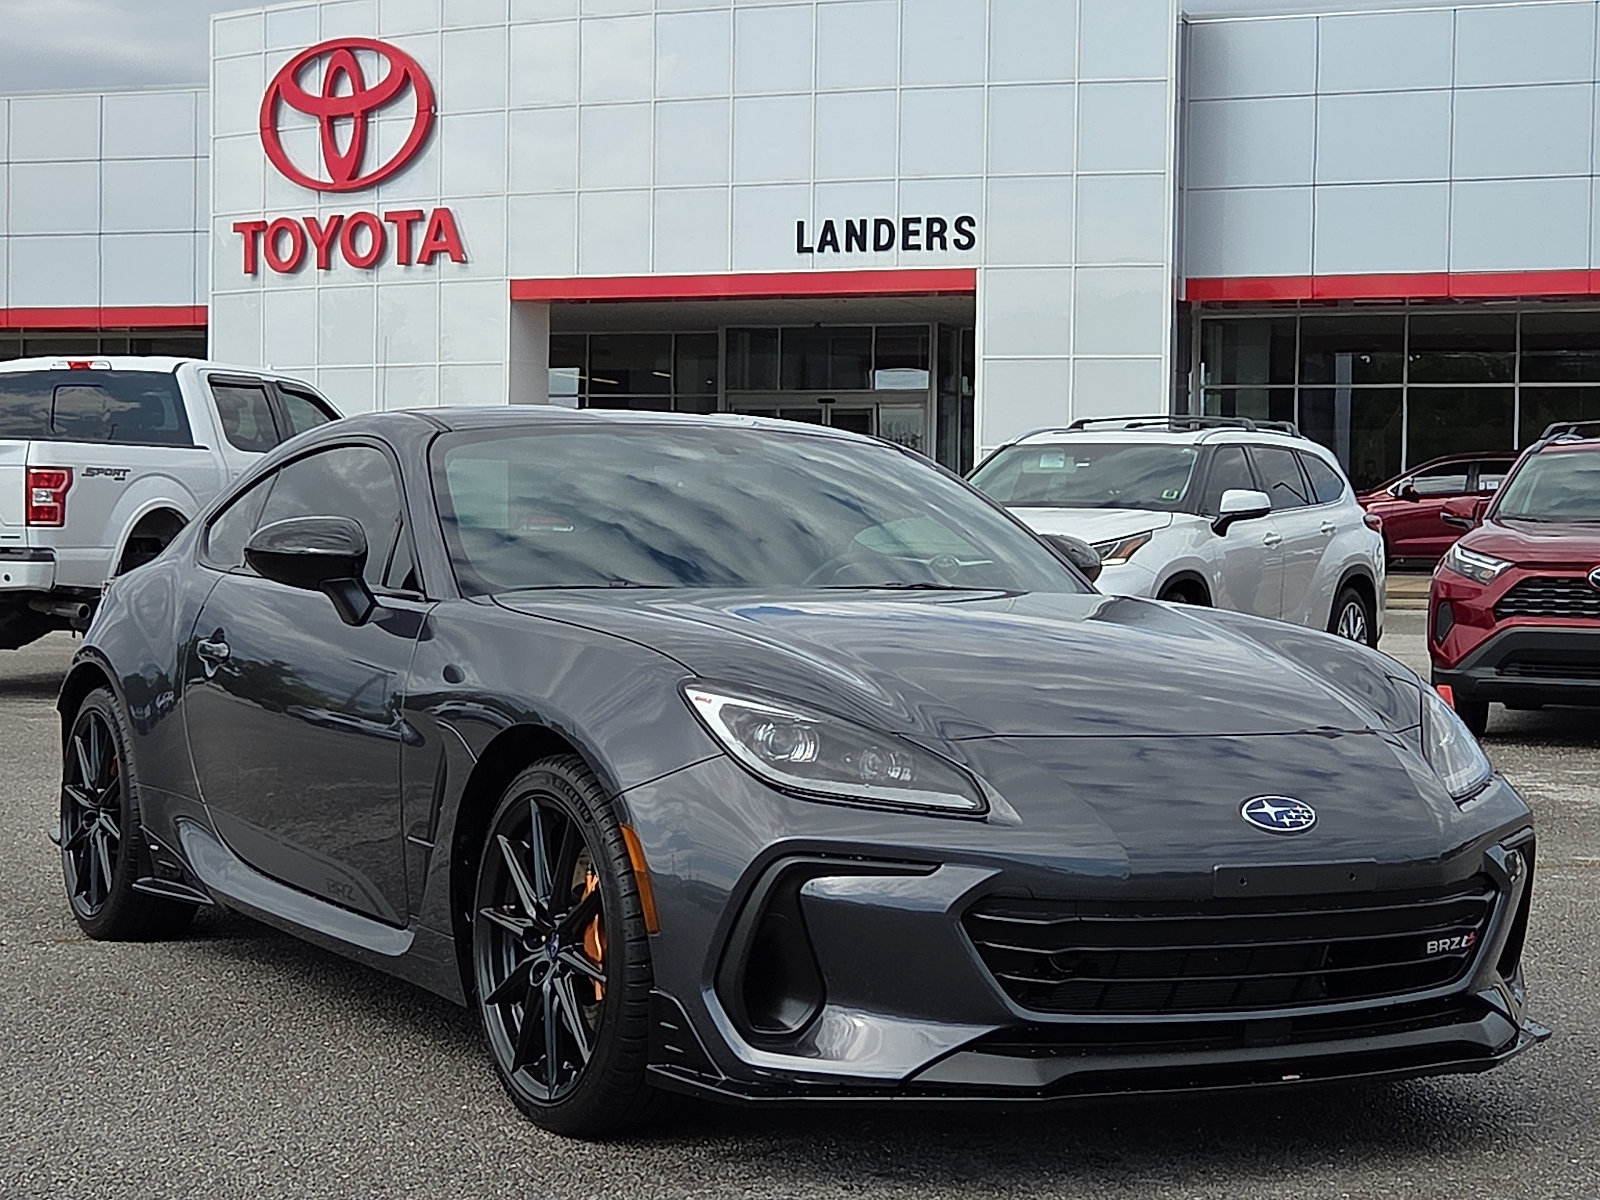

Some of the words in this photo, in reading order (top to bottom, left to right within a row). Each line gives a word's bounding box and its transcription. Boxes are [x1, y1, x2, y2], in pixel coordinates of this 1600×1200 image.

[233, 208, 467, 274] TOYOTA
[797, 216, 976, 253] LANDERS
[81, 467, 131, 477] SPORT
